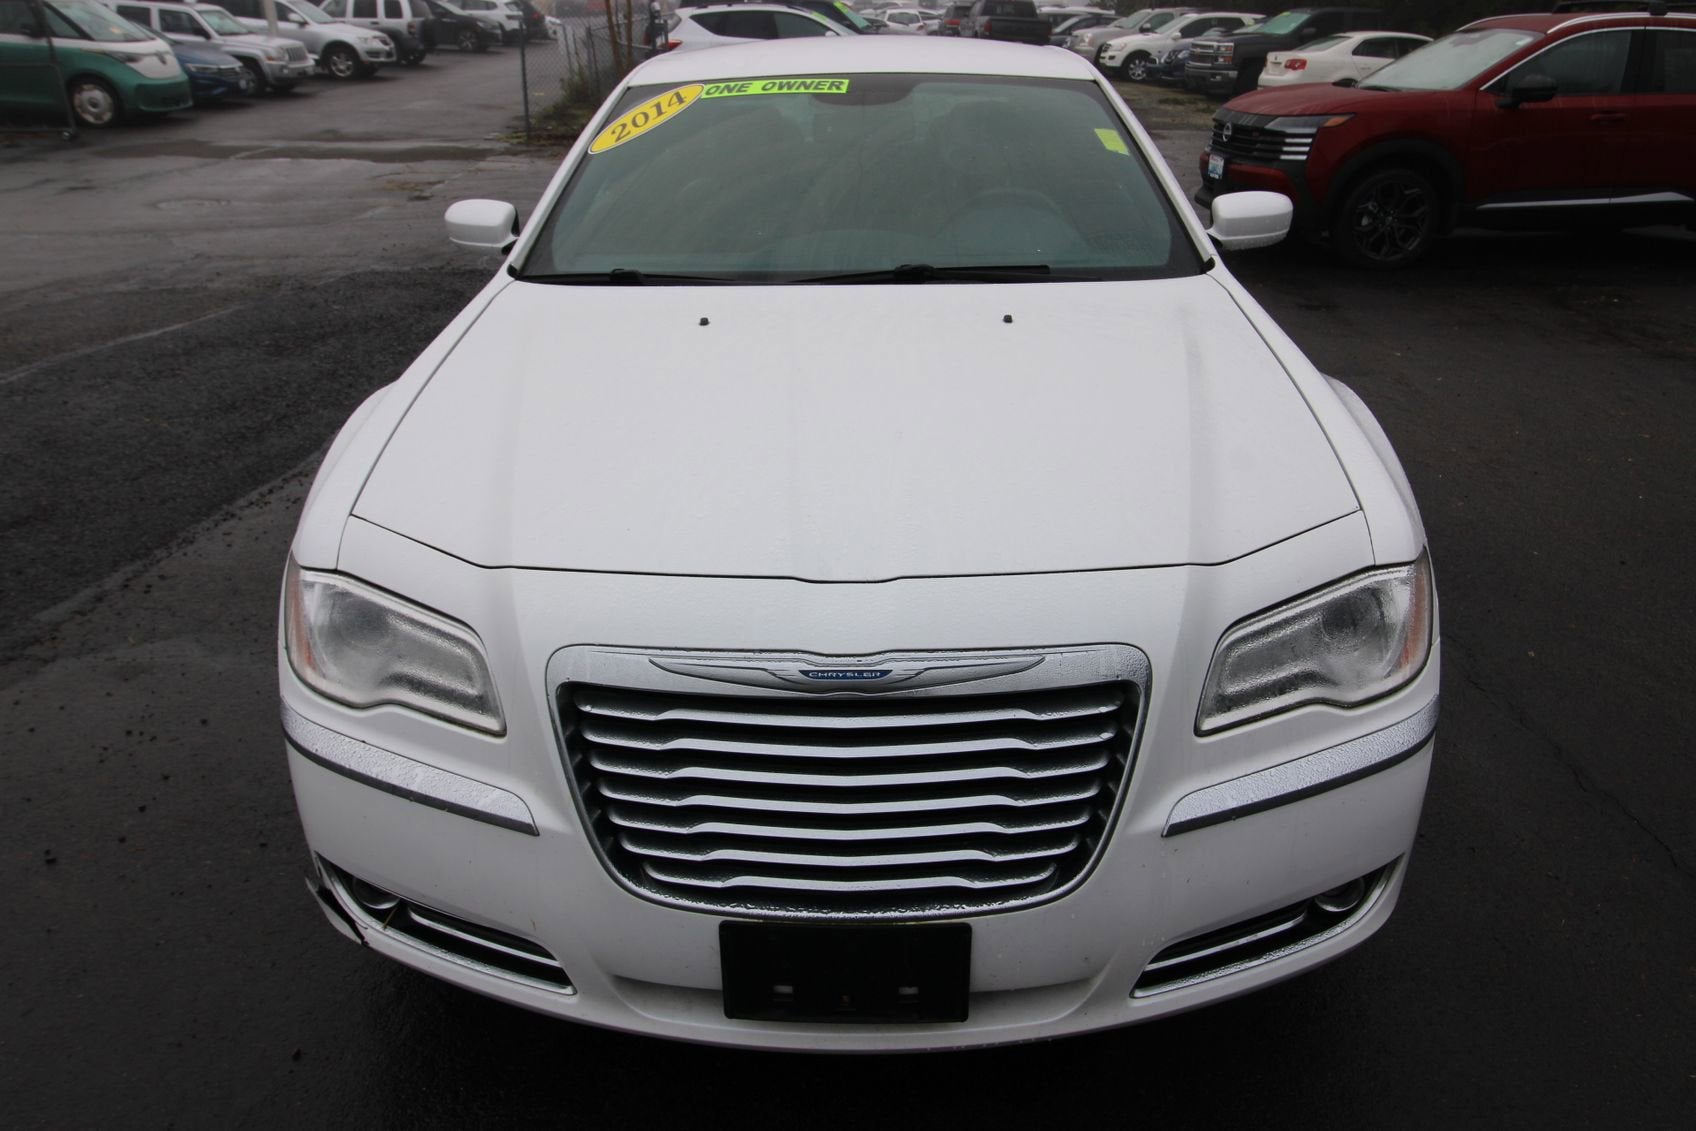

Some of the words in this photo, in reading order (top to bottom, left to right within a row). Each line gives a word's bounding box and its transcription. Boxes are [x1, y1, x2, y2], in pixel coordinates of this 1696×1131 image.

[705, 82, 752, 96] ONE
[761, 80, 845, 92] OWNER
[610, 90, 687, 143] 2014
